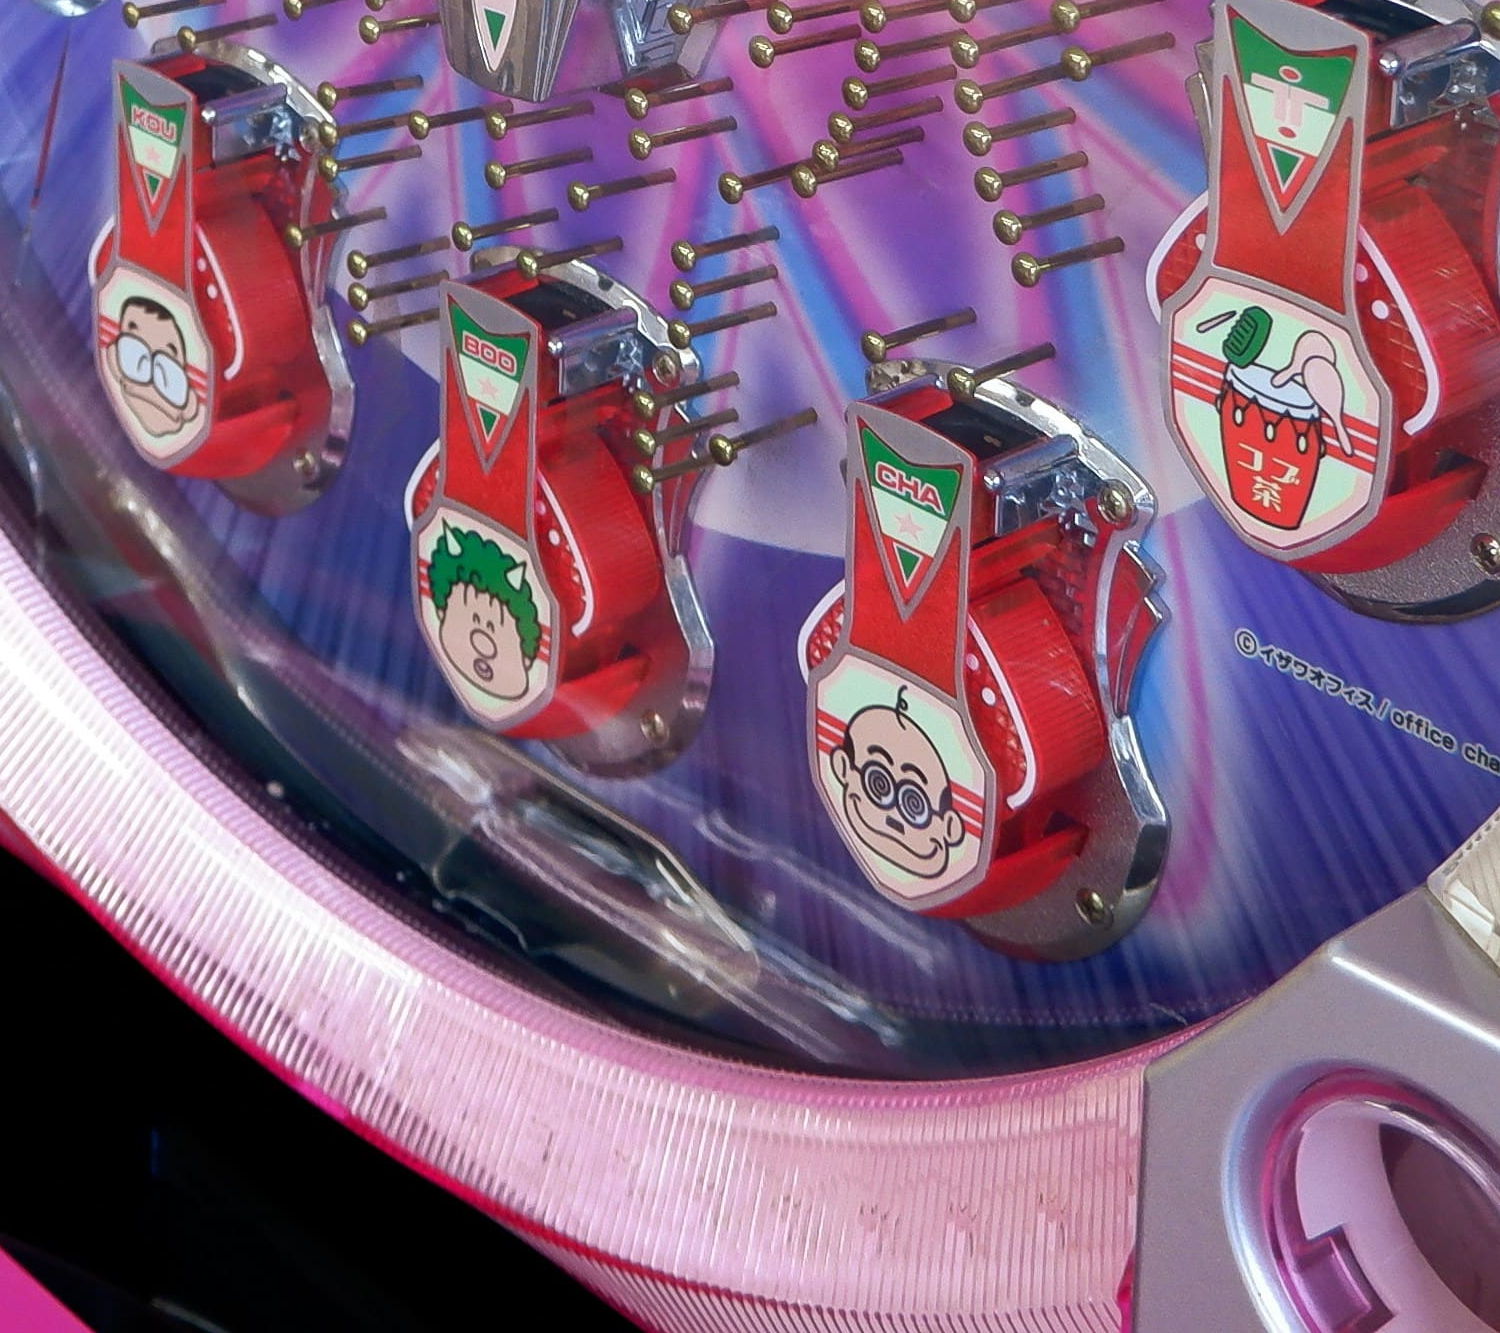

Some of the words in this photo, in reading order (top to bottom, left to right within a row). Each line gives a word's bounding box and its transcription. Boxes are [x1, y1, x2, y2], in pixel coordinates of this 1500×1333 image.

[131, 106, 176, 141] KOU
[463, 333, 518, 374] BOO
[874, 461, 942, 511] CHA
[1391, 709, 1457, 751] office
